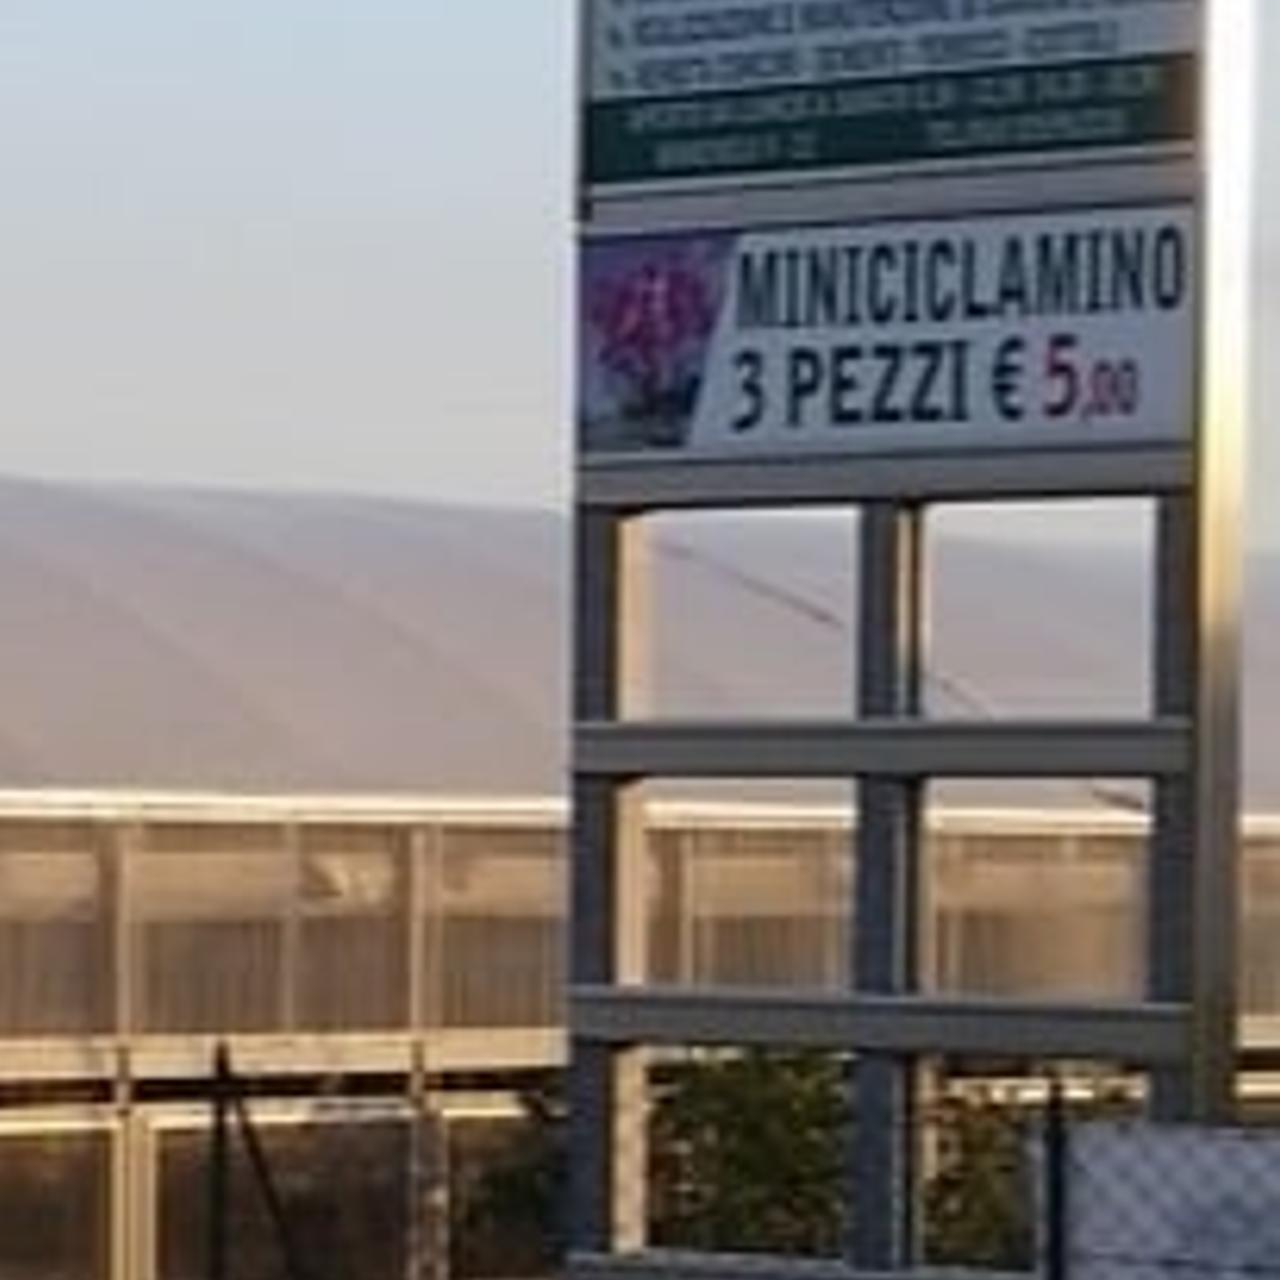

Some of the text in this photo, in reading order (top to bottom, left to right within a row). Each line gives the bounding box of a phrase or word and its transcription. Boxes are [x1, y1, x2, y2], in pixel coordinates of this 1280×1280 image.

[737, 227, 1185, 328] MINICICLAMINO
[730, 350, 765, 432] 3
[786, 339, 971, 428] PEZZI
[991, 336, 1026, 422] €
